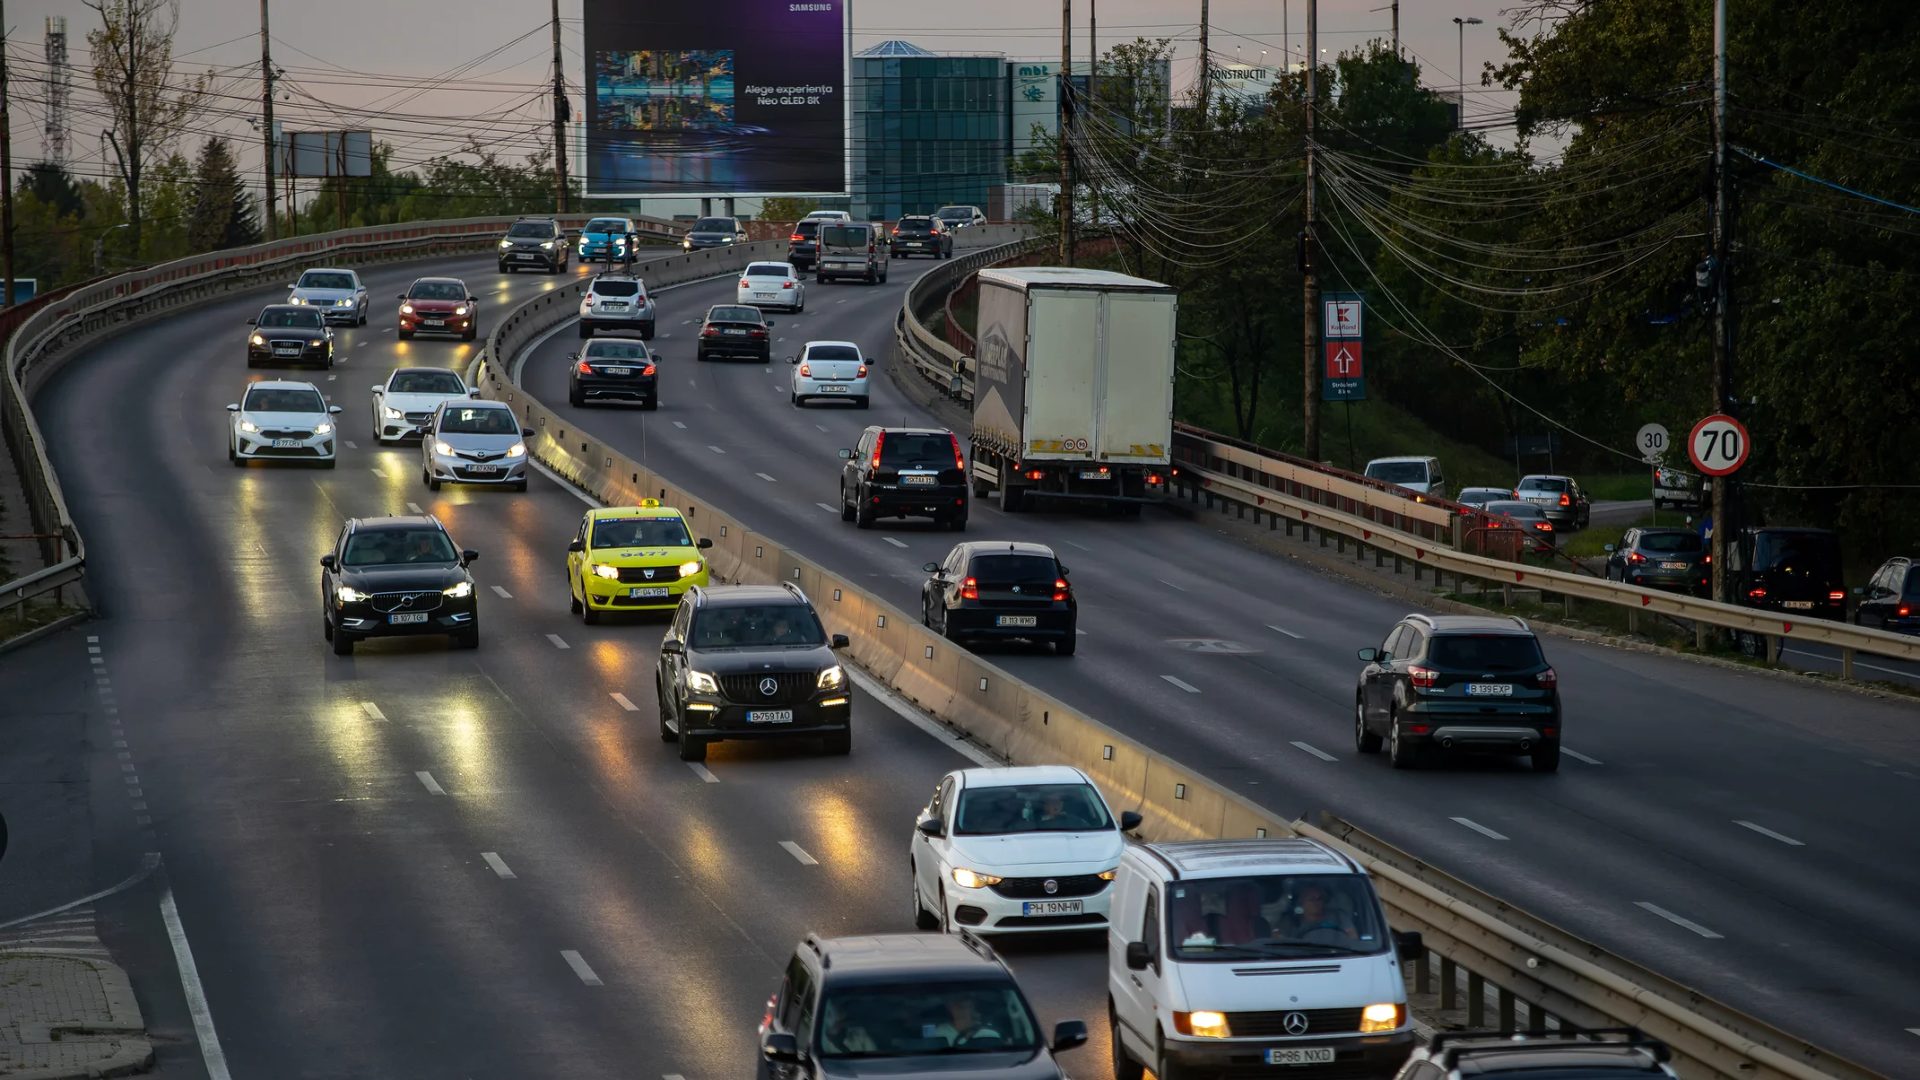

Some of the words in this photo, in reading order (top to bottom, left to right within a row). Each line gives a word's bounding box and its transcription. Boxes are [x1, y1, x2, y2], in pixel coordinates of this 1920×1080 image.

[789, 3, 832, 12] SAMSUNG
[1018, 65, 1048, 76] mbt
[745, 85, 774, 96] Alege
[757, 96, 778, 105] Neo
[807, 96, 820, 105] 8K
[1644, 432, 1663, 449] 30
[1702, 429, 1738, 462] 70
[1001, 616, 1007, 624] B
[1471, 685, 1477, 693] B
[1479, 685, 1492, 693] 139
[1492, 685, 1510, 693] EXP
[760, 712, 775, 721] 759
[1029, 903, 1043, 914] PH
[1047, 903, 1057, 913] 19
[1058, 902, 1080, 912] NHW
[1273, 1051, 1281, 1063] B
[1304, 1049, 1331, 1061] NXD
